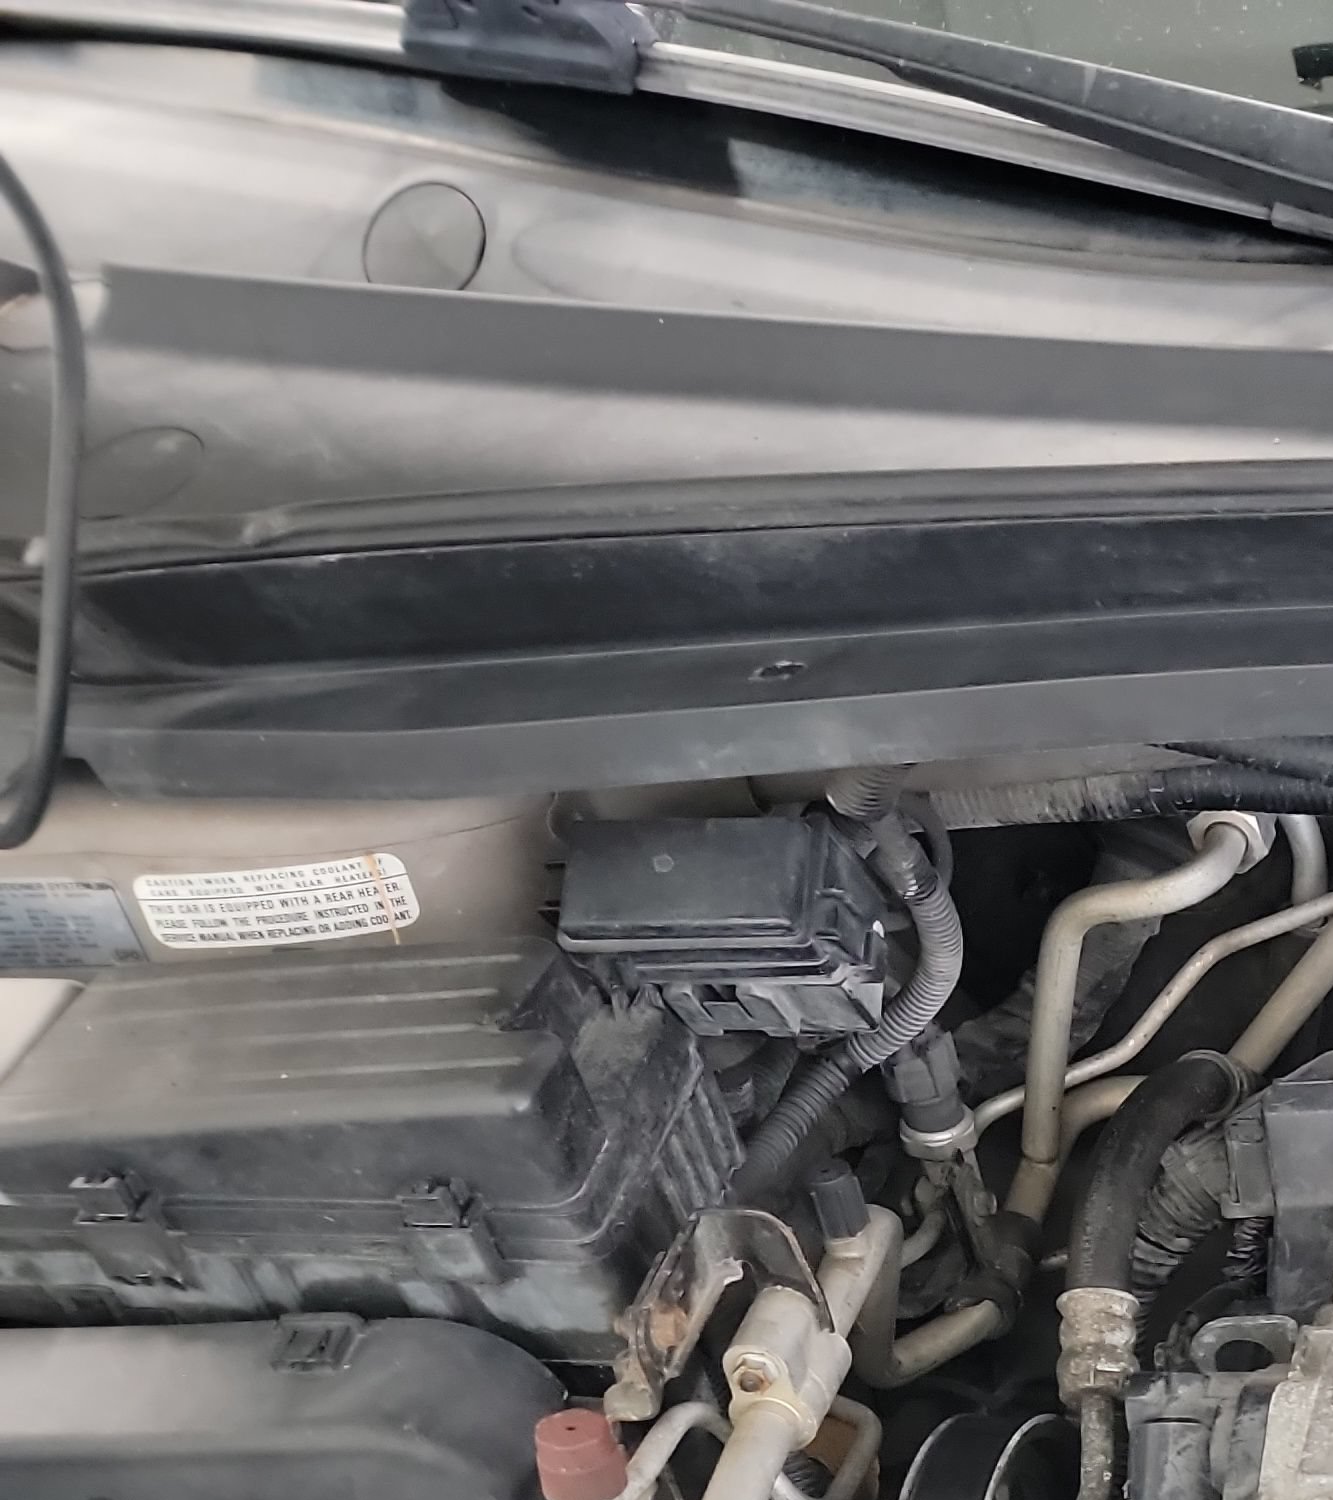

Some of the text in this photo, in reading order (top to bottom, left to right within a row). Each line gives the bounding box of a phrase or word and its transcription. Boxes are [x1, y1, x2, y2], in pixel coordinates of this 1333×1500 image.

[312, 861, 362, 876] COOLANT
[219, 899, 275, 913] EQUIPPED
[279, 896, 309, 908] WITH
[313, 895, 322, 905] A
[323, 890, 355, 903] REAR
[356, 882, 402, 898] HEAER.
[389, 895, 408, 908] THE
[266, 925, 317, 939] REPLACING
[369, 910, 414, 926] COOANT.
